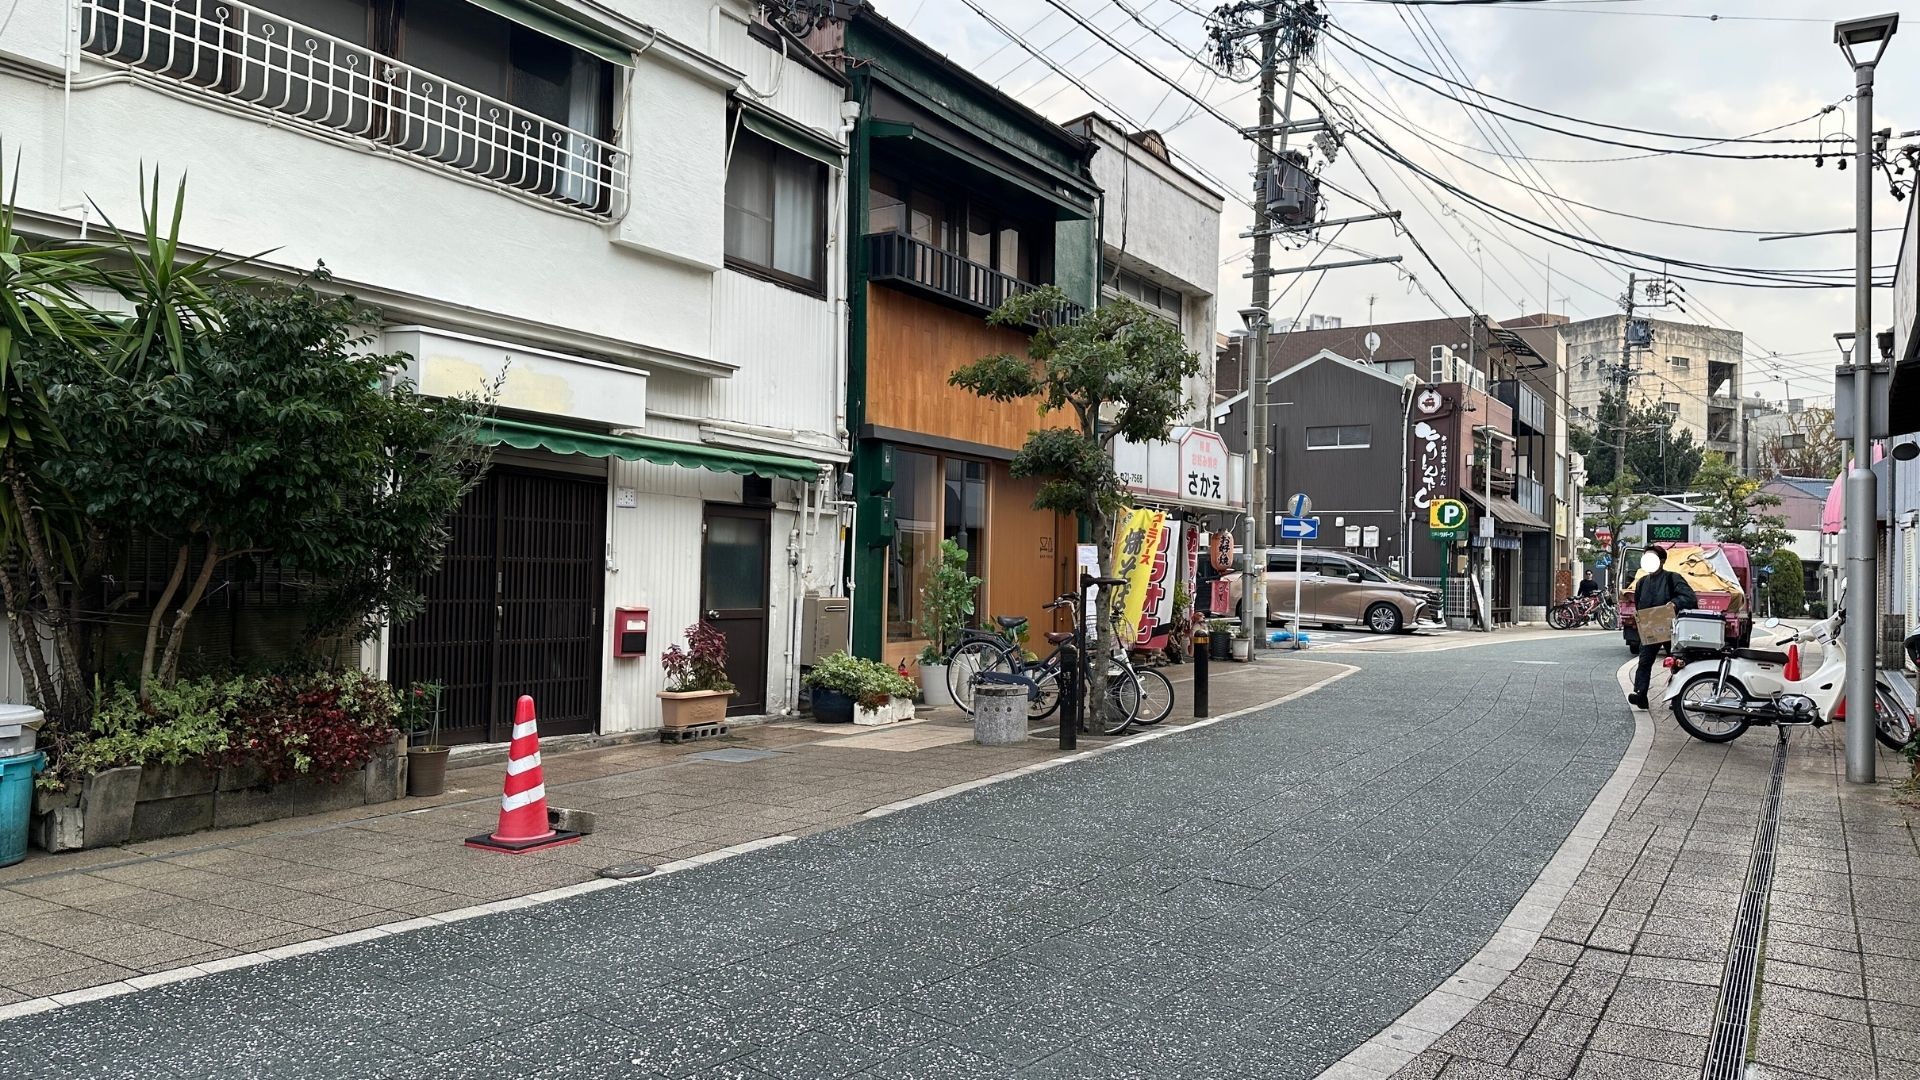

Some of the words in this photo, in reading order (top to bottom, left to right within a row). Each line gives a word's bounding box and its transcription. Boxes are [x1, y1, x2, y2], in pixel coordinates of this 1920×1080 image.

[1188, 470, 1221, 499] さかえ
[1444, 505, 1459, 524] P
[1139, 513, 1163, 565] コーミソース
[1113, 528, 1146, 609] 焼そば
